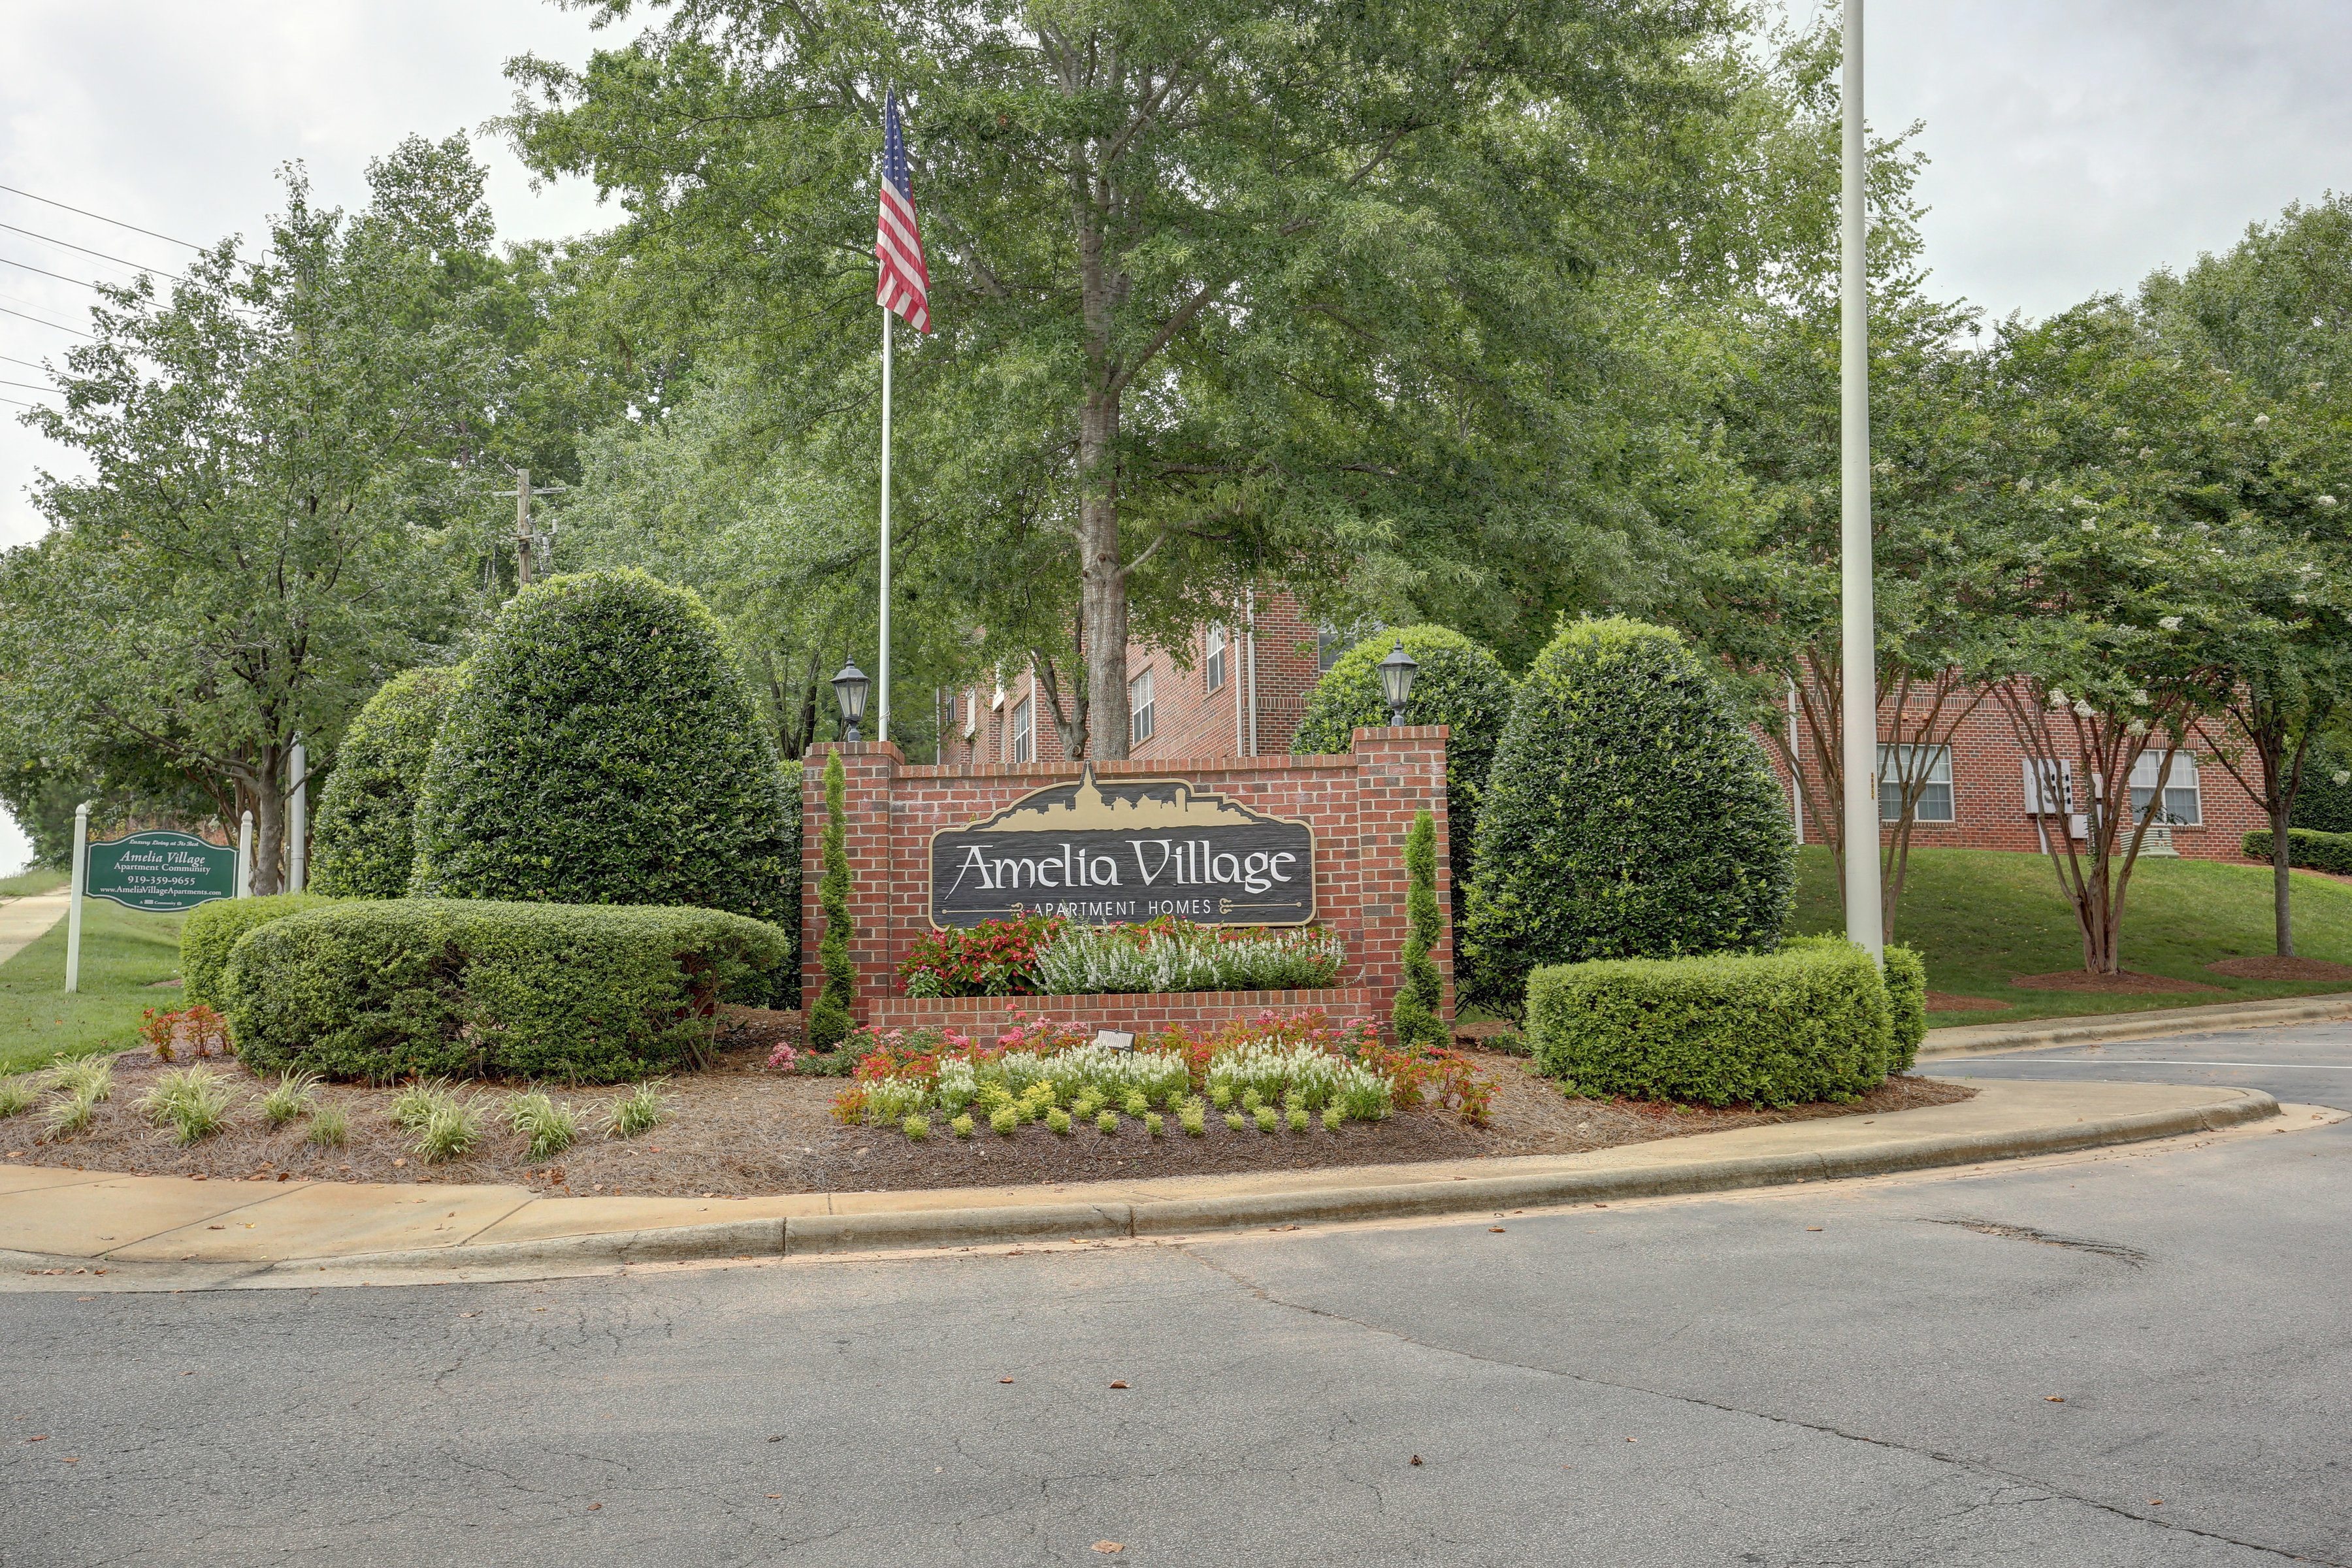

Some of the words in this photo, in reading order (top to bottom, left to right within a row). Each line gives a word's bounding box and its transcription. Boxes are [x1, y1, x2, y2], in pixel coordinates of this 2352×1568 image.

[120, 851, 163, 863] Amelia
[167, 852, 205, 868] Village
[114, 862, 159, 872] Apartment
[161, 864, 211, 875] Community
[944, 843, 1123, 900] Amelia
[1125, 839, 1296, 894] Village
[128, 875, 195, 886] 919-359-9655
[100, 886, 221, 896] www.AmeliaVillageApartments.com
[1035, 901, 1135, 917] APARTMENT
[1149, 900, 1211, 915] HOMES
